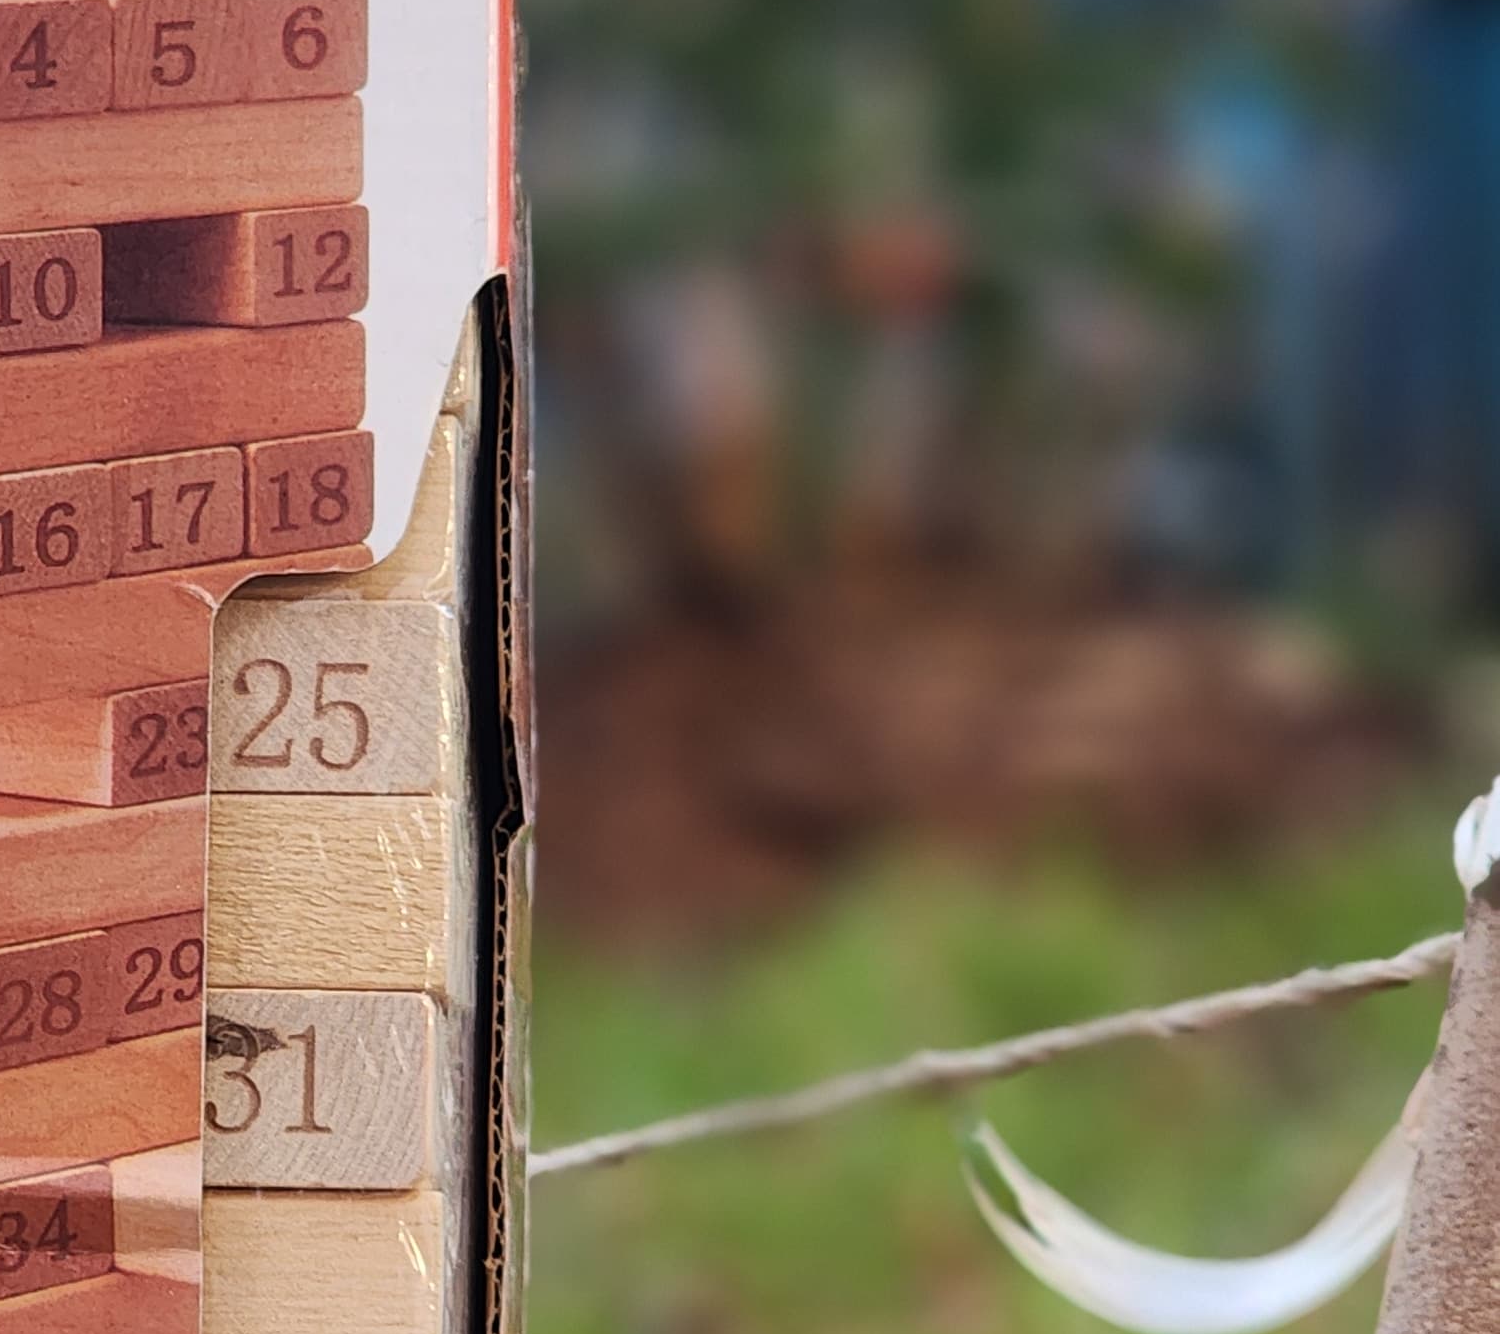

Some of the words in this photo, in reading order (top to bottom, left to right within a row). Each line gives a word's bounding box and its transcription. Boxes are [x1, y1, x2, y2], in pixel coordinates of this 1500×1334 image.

[11, 22, 57, 88] 4
[151, 21, 197, 86] 5
[282, 6, 329, 69] 6
[271, 231, 352, 298] 12
[130, 482, 213, 553] 17
[268, 463, 350, 533] 18
[129, 706, 208, 779] 23
[231, 659, 371, 771] 25
[124, 938, 204, 1015] 29
[204, 1022, 333, 1134] 31
